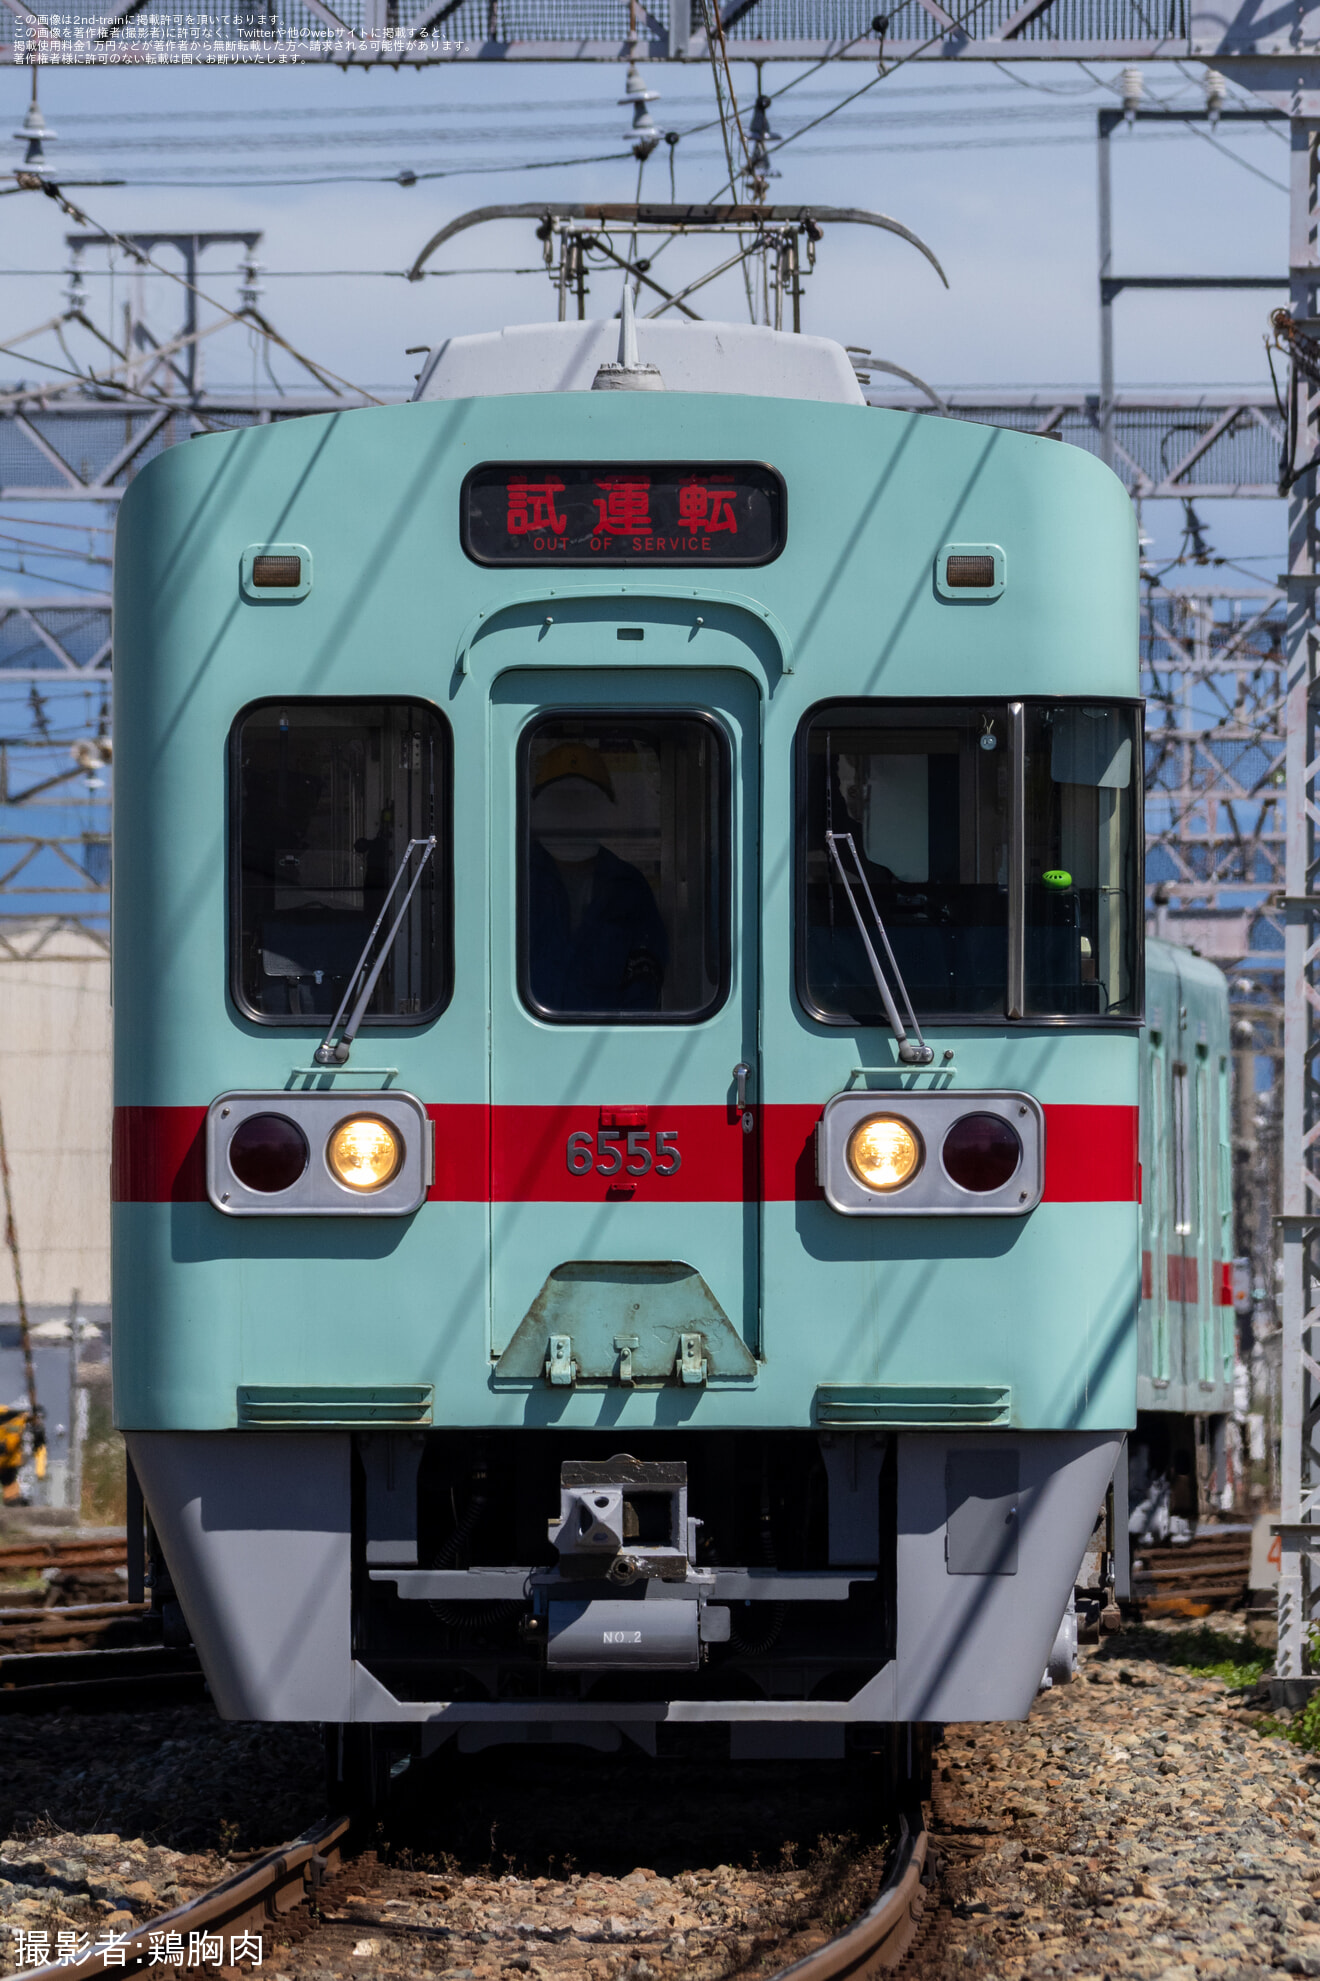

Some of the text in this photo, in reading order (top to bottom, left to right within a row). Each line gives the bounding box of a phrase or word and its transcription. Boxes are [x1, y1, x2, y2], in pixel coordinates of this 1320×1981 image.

[506, 475, 737, 535] 試運転
[533, 537, 712, 551] OUT OF SERVICE
[566, 1131, 682, 1176] 6555
[603, 1631, 642, 1644] NO.2
